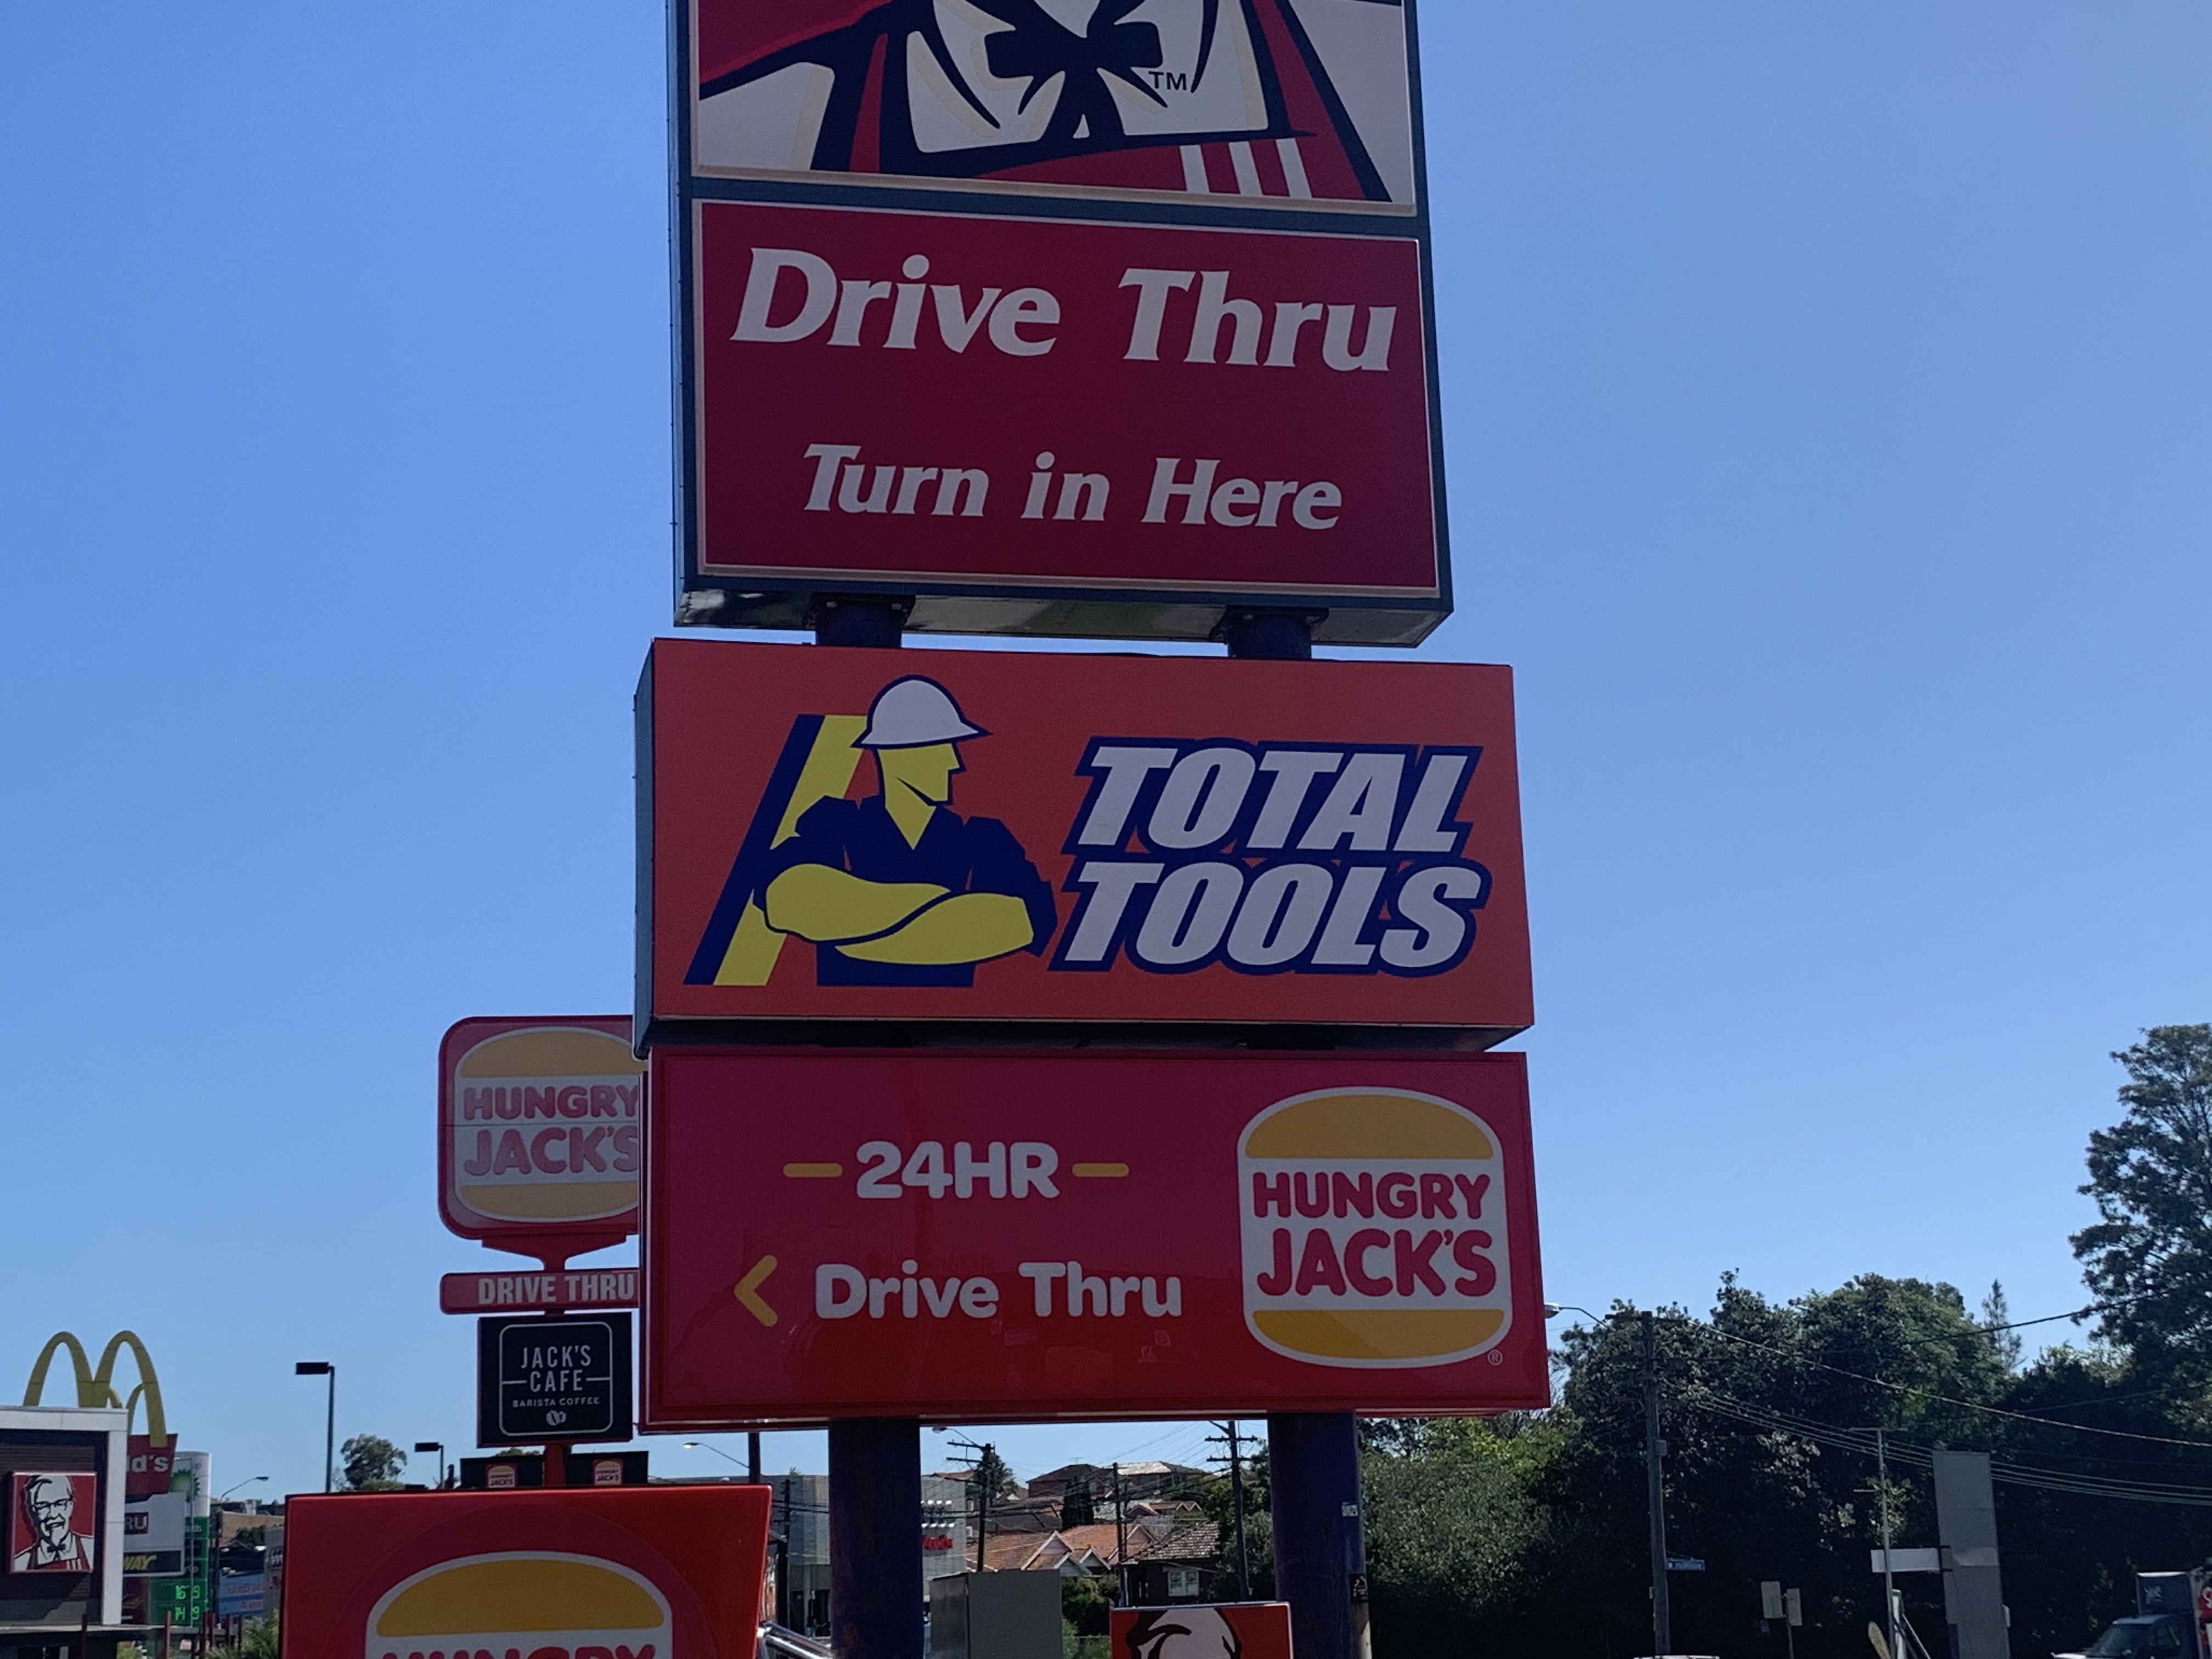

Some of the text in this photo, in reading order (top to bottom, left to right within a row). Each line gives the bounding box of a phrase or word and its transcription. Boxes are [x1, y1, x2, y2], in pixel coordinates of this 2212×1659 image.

[730, 247, 1397, 371] Drive Thru
[803, 443, 1342, 530] Turn in Here
[1076, 743, 1470, 853] TOTAL
[1062, 859, 1487, 969] TOOLS
[856, 1141, 1060, 1199] 24HR
[1253, 1171, 1489, 1219] HUNGRY
[477, 1273, 634, 1305] DRIVE THRU
[815, 1261, 1182, 1318] Drive Thru
[1257, 1228, 1497, 1297] JACK'S
[521, 1345, 591, 1369] JACK'S
[530, 1369, 583, 1392] CAFE
[512, 1397, 600, 1408] BARISTA COFFEE
